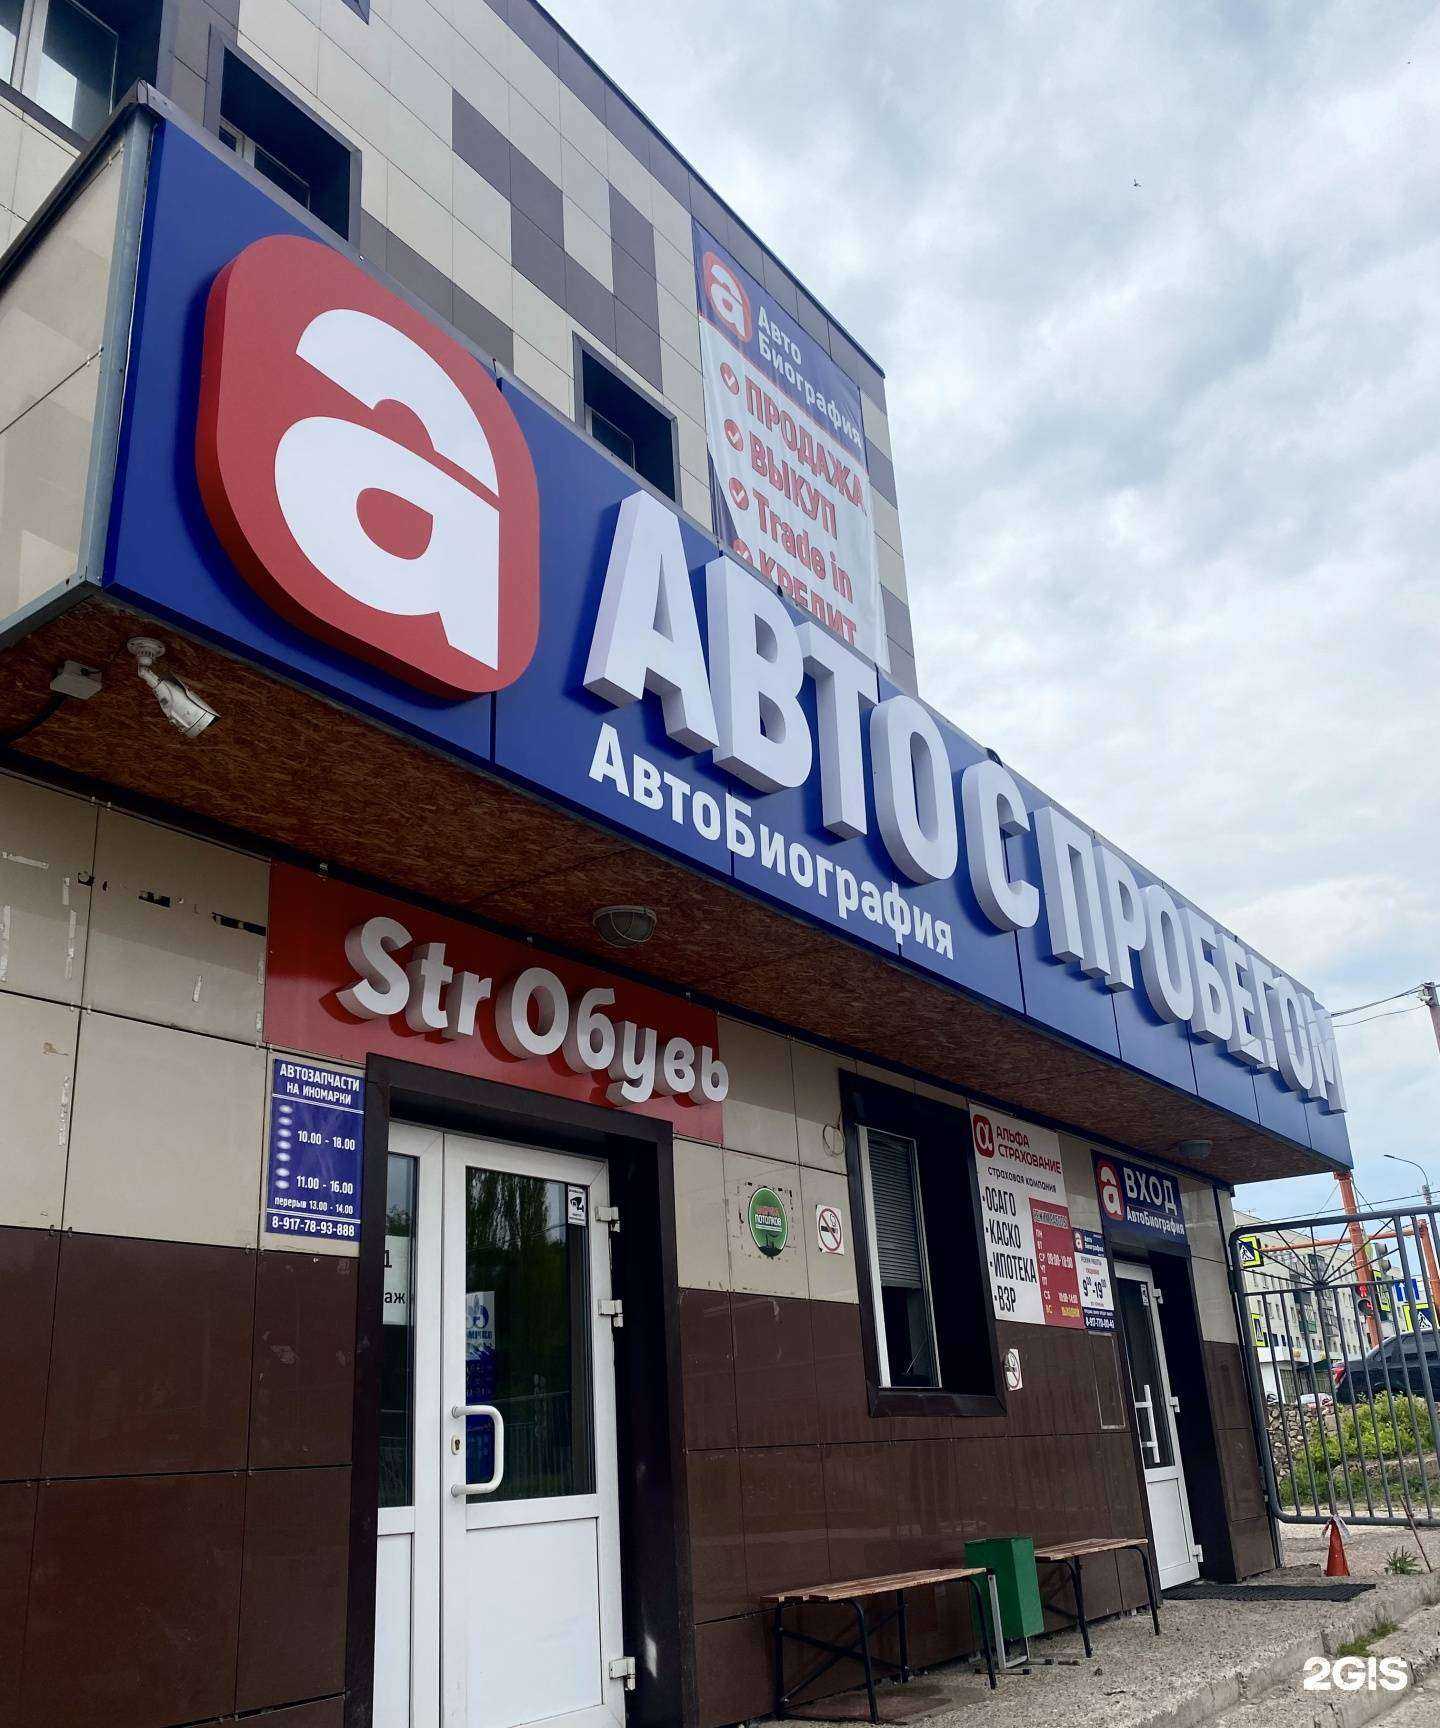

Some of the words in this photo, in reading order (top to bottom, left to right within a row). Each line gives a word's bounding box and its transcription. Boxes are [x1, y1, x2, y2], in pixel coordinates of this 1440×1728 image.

[757, 304, 802, 366] Авто
[758, 333, 863, 449] Биография
[744, 374, 864, 507] ПРОДАЖА
[749, 430, 838, 540] ВЫКУП
[753, 488, 826, 581] Trade
[830, 550, 854, 604] in
[584, 490, 958, 885] АВТО
[962, 759, 1039, 933] С
[1034, 807, 1348, 1114] ПРОБЕГОМ
[588, 722, 954, 960] АвтоБиография
[279, 1063, 360, 1091] АВТОЗАПЧАСТИ
[286, 1081, 300, 1096] НА
[302, 1084, 352, 1105] ИНОМАРКИ
[297, 1130, 322, 1145] 10.00
[332, 1136, 356, 1151] 18.00
[996, 1126, 1030, 1148] АЛЬФА
[998, 1144, 1063, 1175] СТРАХОВАНИЕ
[296, 1175, 320, 1190] 11.00
[330, 1180, 354, 1195] 16.00
[988, 1167, 1025, 1184] страховая
[274, 1196, 307, 1210] перерыв
[335, 1203, 354, 1215] 14.00
[1123, 1167, 1178, 1216] ВХОД
[272, 1216, 355, 1237] 8-917-78-93-888
[1126, 1205, 1185, 1237] АвтоБиография
